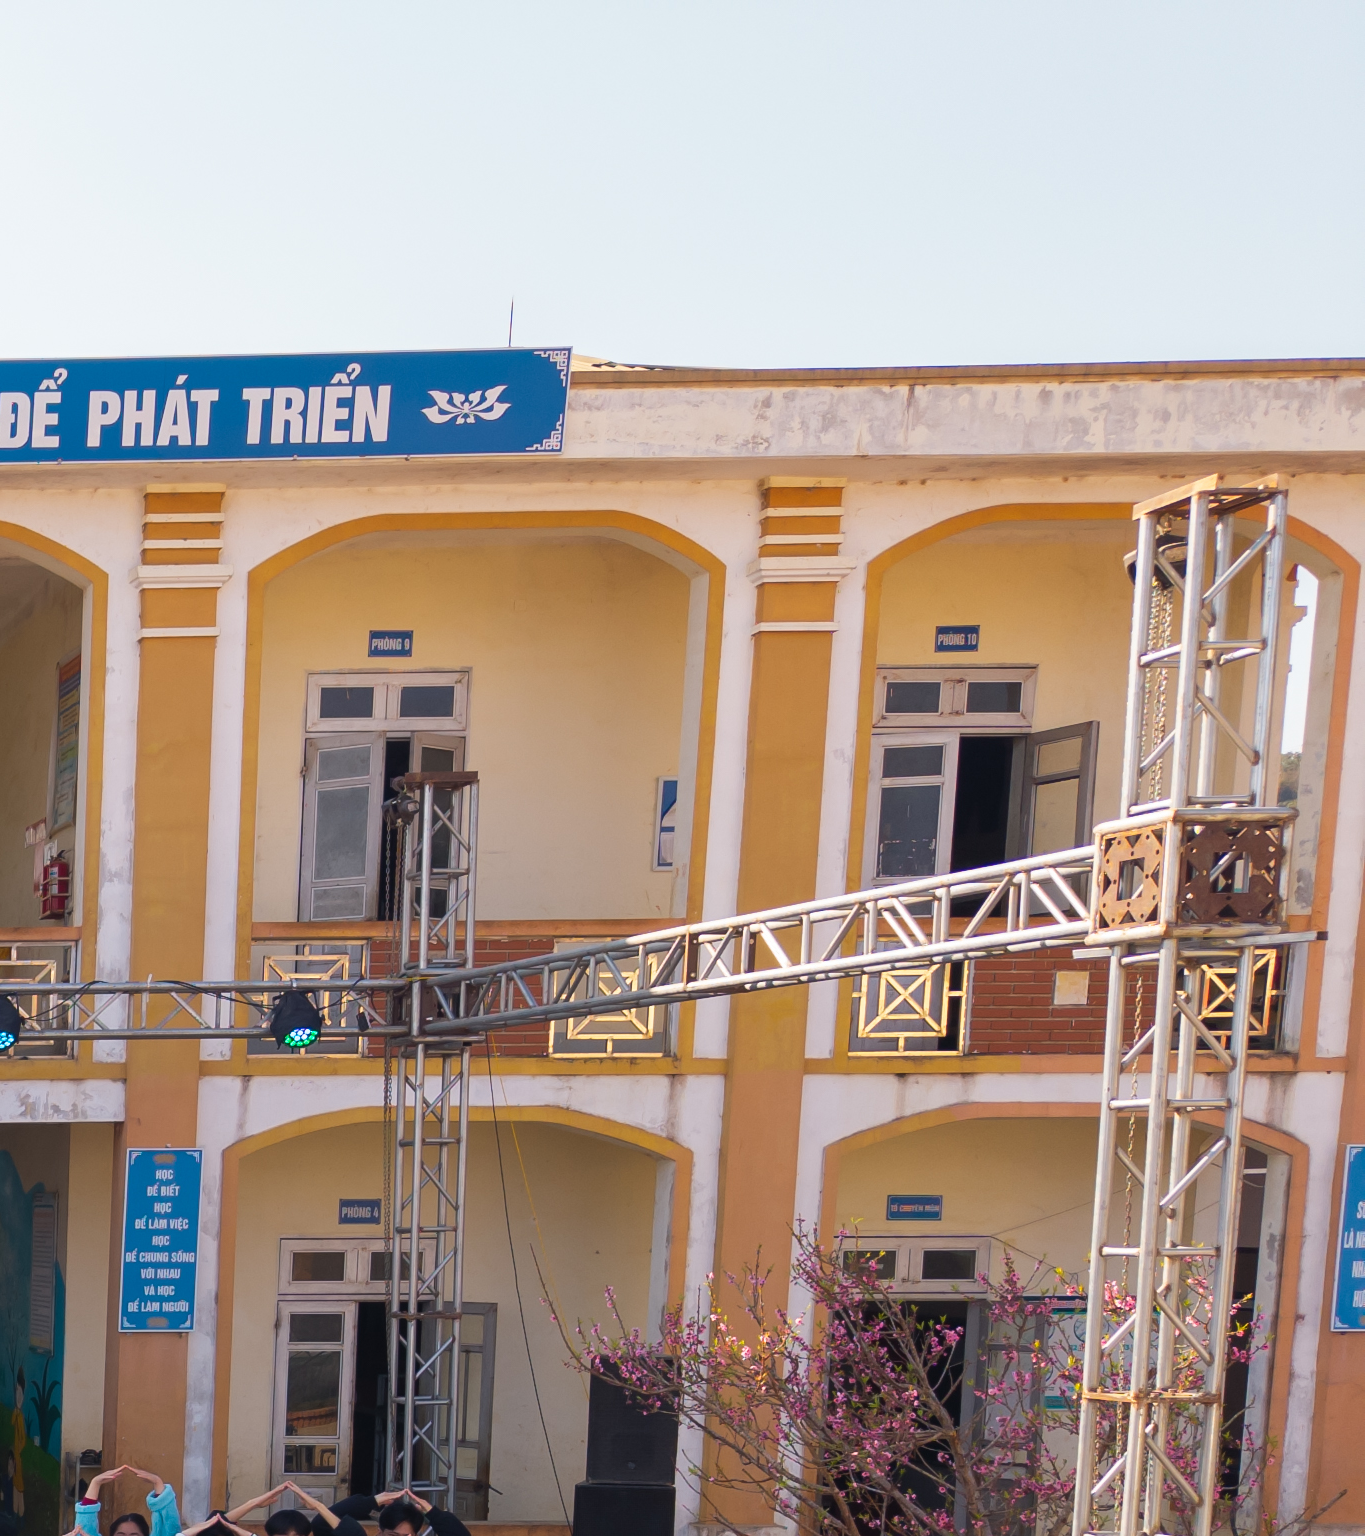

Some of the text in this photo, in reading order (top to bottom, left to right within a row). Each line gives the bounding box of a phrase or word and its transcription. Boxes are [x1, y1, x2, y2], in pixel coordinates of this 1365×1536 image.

[87, 374, 219, 448] PHÁT
[241, 363, 391, 445] TRIỂN
[156, 1169, 174, 1181] HỌC
[154, 1202, 172, 1214] HỌC
[373, 1207, 379, 1217] 4
[149, 1216, 168, 1229] LÀM
[152, 1235, 170, 1247] HỌC
[139, 1251, 169, 1262] CHUNG
[157, 1268, 181, 1279] NHAU
[157, 1285, 175, 1297] HỌC
[141, 1299, 160, 1312] LÀM
